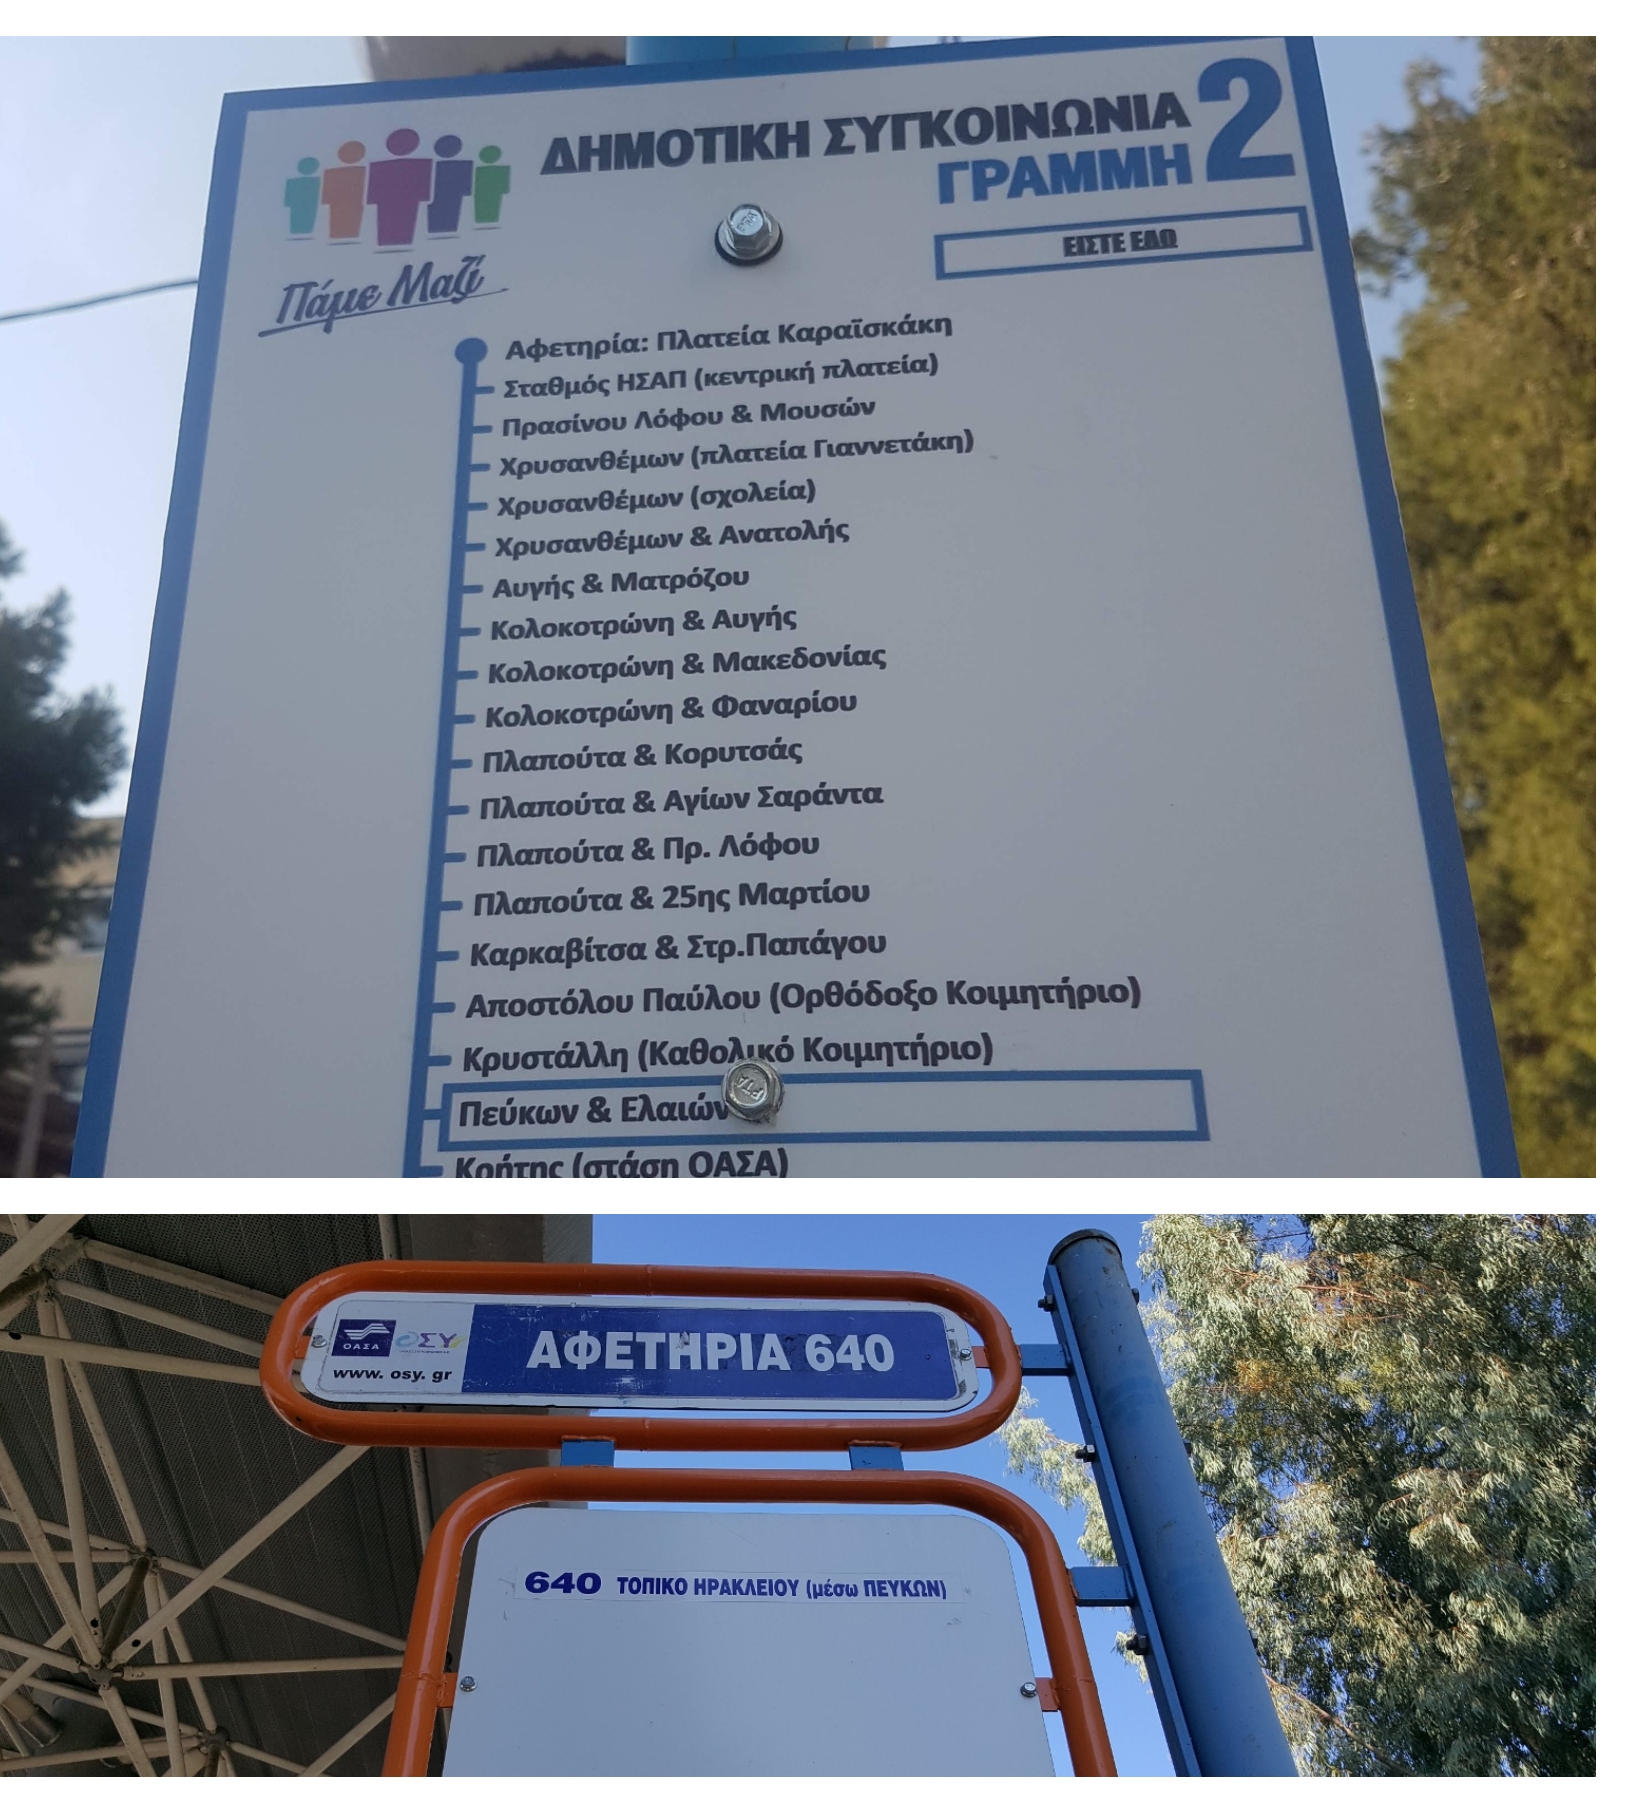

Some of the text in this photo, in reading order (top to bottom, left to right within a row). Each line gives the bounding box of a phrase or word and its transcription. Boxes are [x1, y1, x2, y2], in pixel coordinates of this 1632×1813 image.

[540, 92, 1193, 176] ΔΗΜΟΤΙΚΗ ΣΥΓΚΟΙΝΩΝΙΑ
[937, 56, 1297, 205] ΓΡΑΜΜΗ 2
[1062, 228, 1179, 258] ΕΙΣΤΕ ΕΔΩ
[275, 253, 487, 335] Πάμε Μαζί
[505, 313, 952, 363] Αφετηρία: Πλατεία Καραϊσκάκη
[504, 353, 938, 399] Σταθμός ΗΣΑΠ (κεντρική πλατεία)
[503, 397, 876, 440] Πρασίνου Λόφου & Μουσών
[499, 429, 974, 480] Χρυσανθέμων (πλατεία Γιαννετάκη)
[497, 479, 816, 520] Χρυσανθέμων (σχολεία)
[495, 518, 850, 561] Χρυσανθέμων & Ανατολής
[492, 567, 749, 601] Αυγής & Ματρόζου
[491, 605, 797, 640] Κολοκοτρώνη & Αυγής
[489, 644, 886, 684] Κολοκοτρώνη & Μακεδονίας
[486, 690, 857, 728] Κολοκοτρώνη & Φαναρίου
[483, 737, 803, 773] Πλαπούτα & Κορυτσάς
[480, 782, 884, 820] Πλαπούτα & Αγίων Σαράντα
[477, 832, 819, 867] Πλαπούτα & Πρ. Λόφου
[474, 878, 870, 916] Πλαπούτα & 25ης Μαρτίου
[471, 929, 886, 971] Καρκαβίτσα & Στρ.Παπάγου
[466, 976, 1141, 1018] Αποστόλου Παύλου (Ορθόδοξο Κοιμητήριο)
[463, 1032, 993, 1077] Κρυστάλλη (Καθολικό Κοιμητήριο)
[459, 1090, 729, 1127] Πεύκων & Ελαιών
[456, 1147, 788, 1178] Κρήτης (στάση ΟΑΣΑ)
[342, 1342, 380, 1351] ΟΑΣΑ
[525, 1330, 895, 1372] ΑΦΕΤΗΡΙΑ 640
[333, 1369, 453, 1383] www. osy. gr
[524, 1571, 948, 1600] 640 ΤΟΠΙΚΟ ΗΡΑΚΛΕΙΟΥ (μέσω ΠΕΥΚΩΝ)
